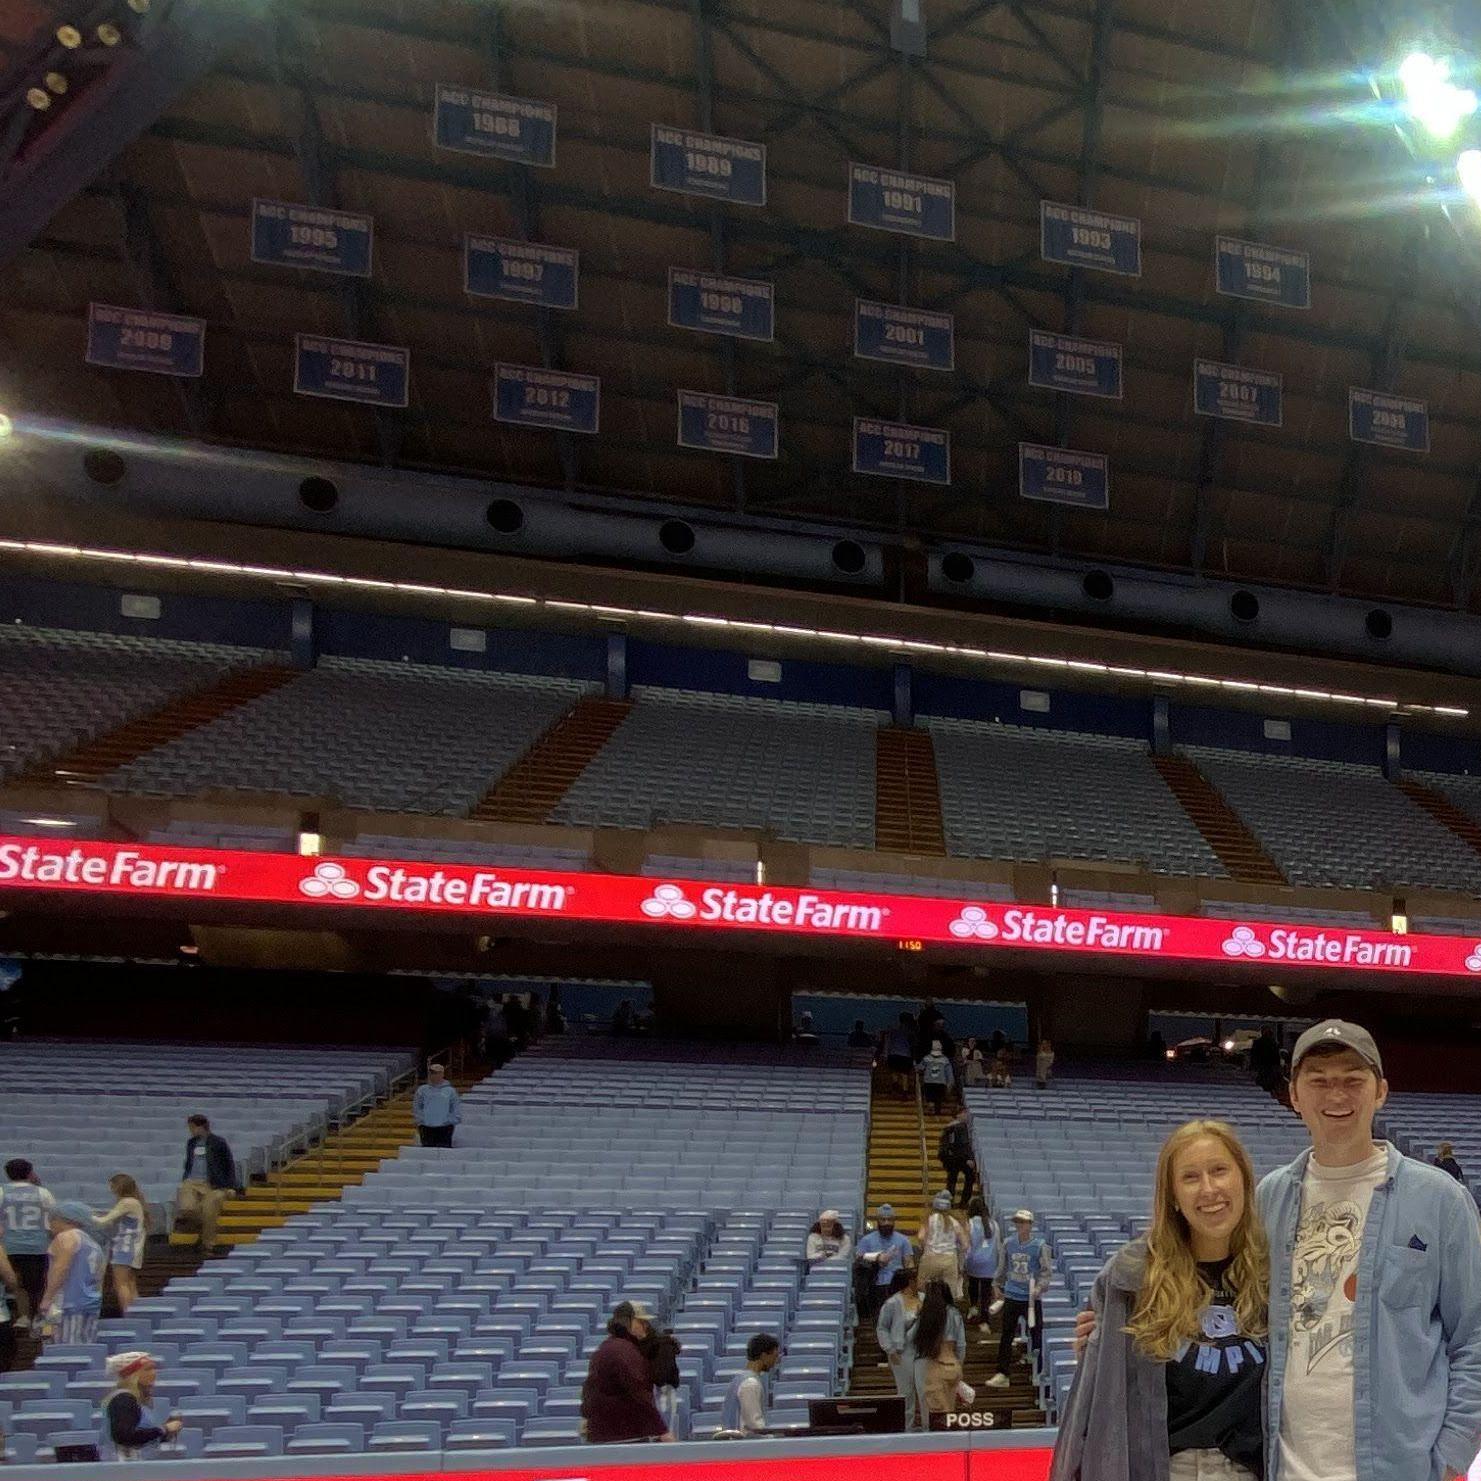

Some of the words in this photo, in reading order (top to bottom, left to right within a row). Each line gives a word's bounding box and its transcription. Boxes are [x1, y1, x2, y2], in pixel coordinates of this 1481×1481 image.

[330, 359, 376, 380] 2011
[524, 386, 570, 408] 2012
[882, 440, 920, 459] 2017
[946, 1412, 994, 1427] POSS
